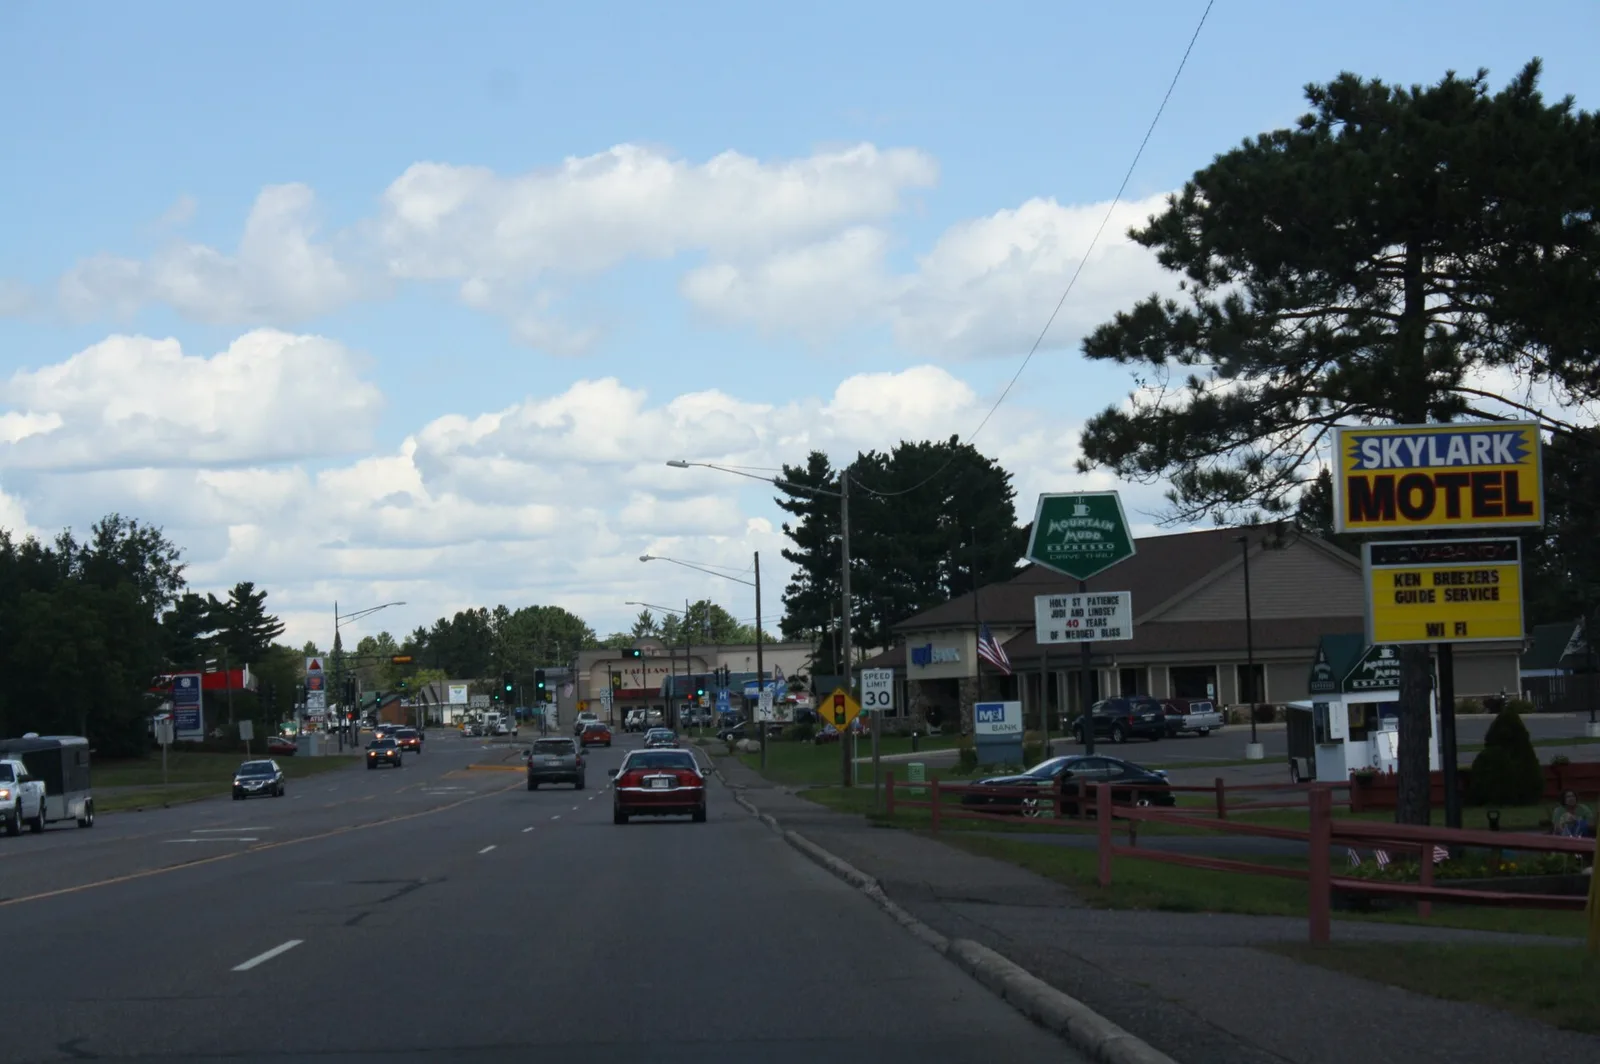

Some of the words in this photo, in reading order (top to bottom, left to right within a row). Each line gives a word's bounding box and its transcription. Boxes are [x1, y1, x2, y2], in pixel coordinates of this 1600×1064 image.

[1361, 433, 1515, 469] SKYLARK
[1347, 470, 1534, 522] MOTEL
[1047, 517, 1115, 536] MOUNTAIN
[1063, 531, 1102, 544] MUDD
[1394, 573, 1421, 587] KEN
[1433, 570, 1500, 586] BREEZERS
[1049, 599, 1067, 608] HOLY
[1072, 598, 1081, 606] ST
[1087, 596, 1119, 606] PATIENCE
[1395, 589, 1436, 603] GUIDE
[1444, 587, 1500, 601] SERVICE
[1051, 609, 1066, 618] JUDI
[1071, 608, 1084, 617] AND
[1088, 607, 1116, 616] LINDSEY
[1066, 619, 1079, 628] 40
[1086, 618, 1107, 627] YEARS
[1426, 622, 1445, 637] WI
[1454, 621, 1467, 636] FI
[1050, 631, 1059, 640] OF
[1065, 629, 1095, 639] WEDDED
[1101, 628, 1121, 637] BLISS
[864, 672, 890, 680] SPEED
[865, 691, 890, 706] 30
[979, 707, 1003, 722] M&I
